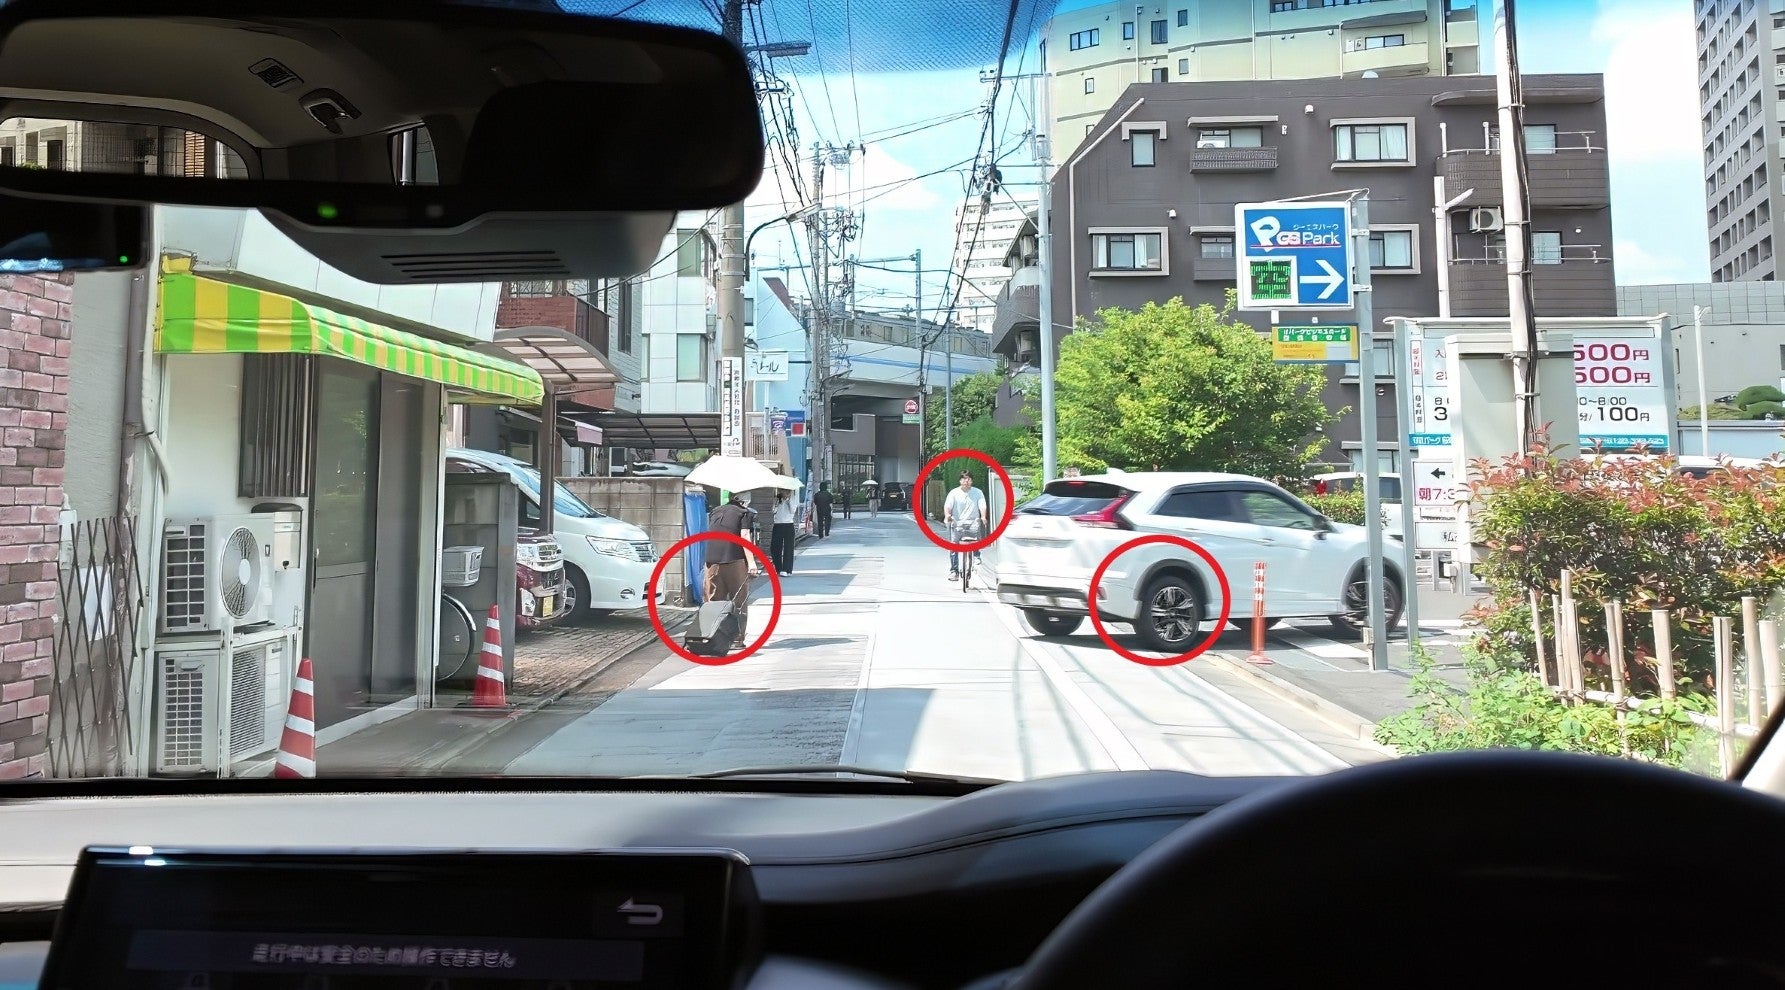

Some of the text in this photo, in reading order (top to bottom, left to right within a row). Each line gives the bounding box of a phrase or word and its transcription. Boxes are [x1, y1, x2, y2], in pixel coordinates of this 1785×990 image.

[1302, 231, 1340, 245] Park
[1434, 344, 1650, 362] 入 500円
[1575, 366, 1651, 384] 500円
